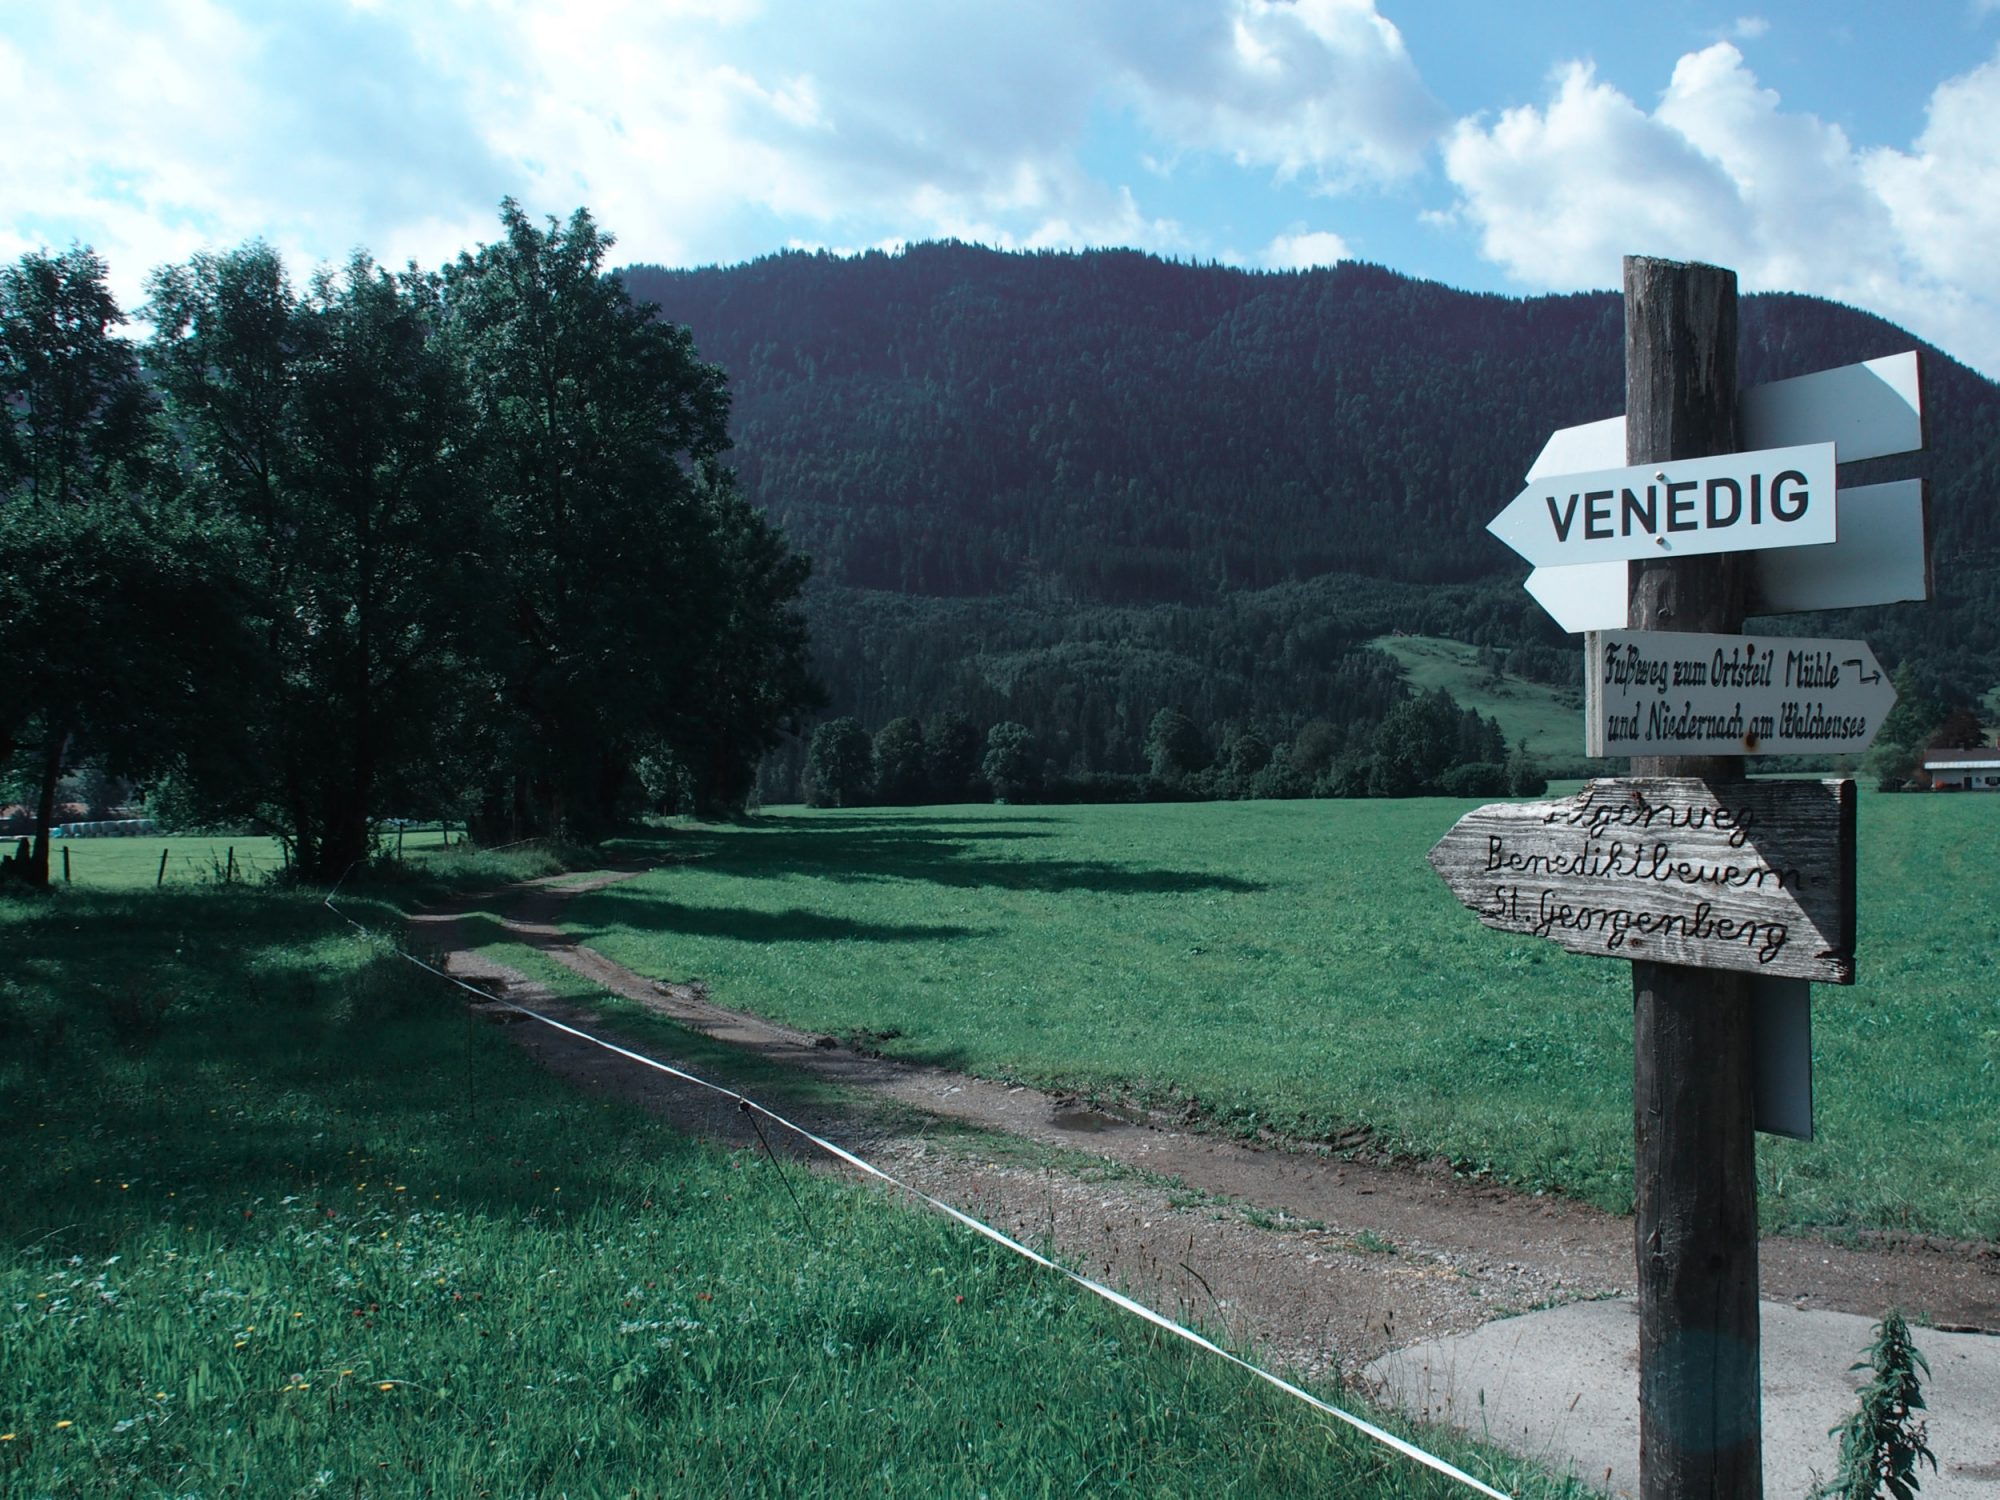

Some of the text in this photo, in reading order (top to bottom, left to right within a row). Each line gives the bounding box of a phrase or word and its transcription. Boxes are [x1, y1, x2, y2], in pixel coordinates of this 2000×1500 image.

[1546, 470, 1809, 542] VENEDIG
[1605, 643, 1840, 696] Fußweg zum Ortsteil Mühle
[1607, 701, 1866, 741] und Niedernach am Walchensee
[1495, 885, 1789, 964] St. Georgenberg
